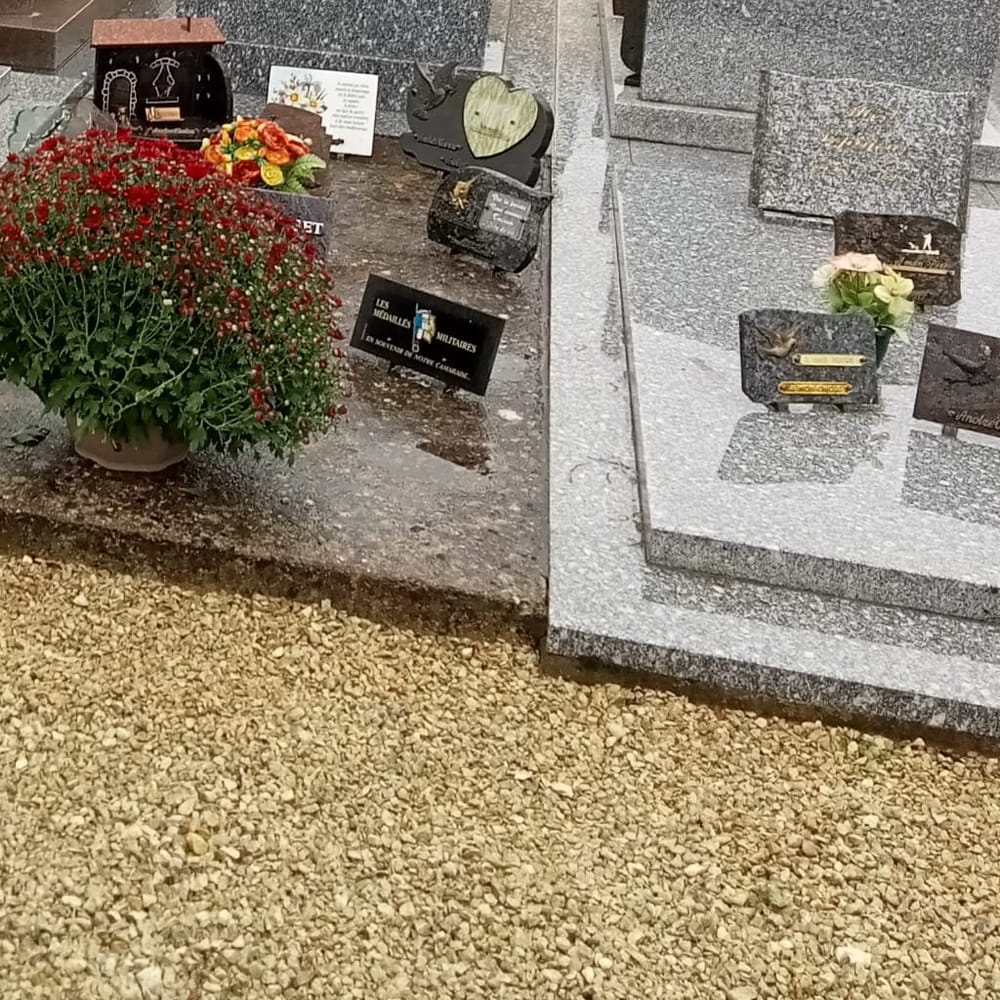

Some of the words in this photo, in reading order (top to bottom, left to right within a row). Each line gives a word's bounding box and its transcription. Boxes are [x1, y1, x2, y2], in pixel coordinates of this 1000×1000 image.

[375, 298, 390, 310] LES
[374, 337, 404, 354] SOUVENIR
[404, 350, 413, 358] DE
[414, 353, 435, 367] NOTRE
[436, 331, 478, 353] MILITAIRES
